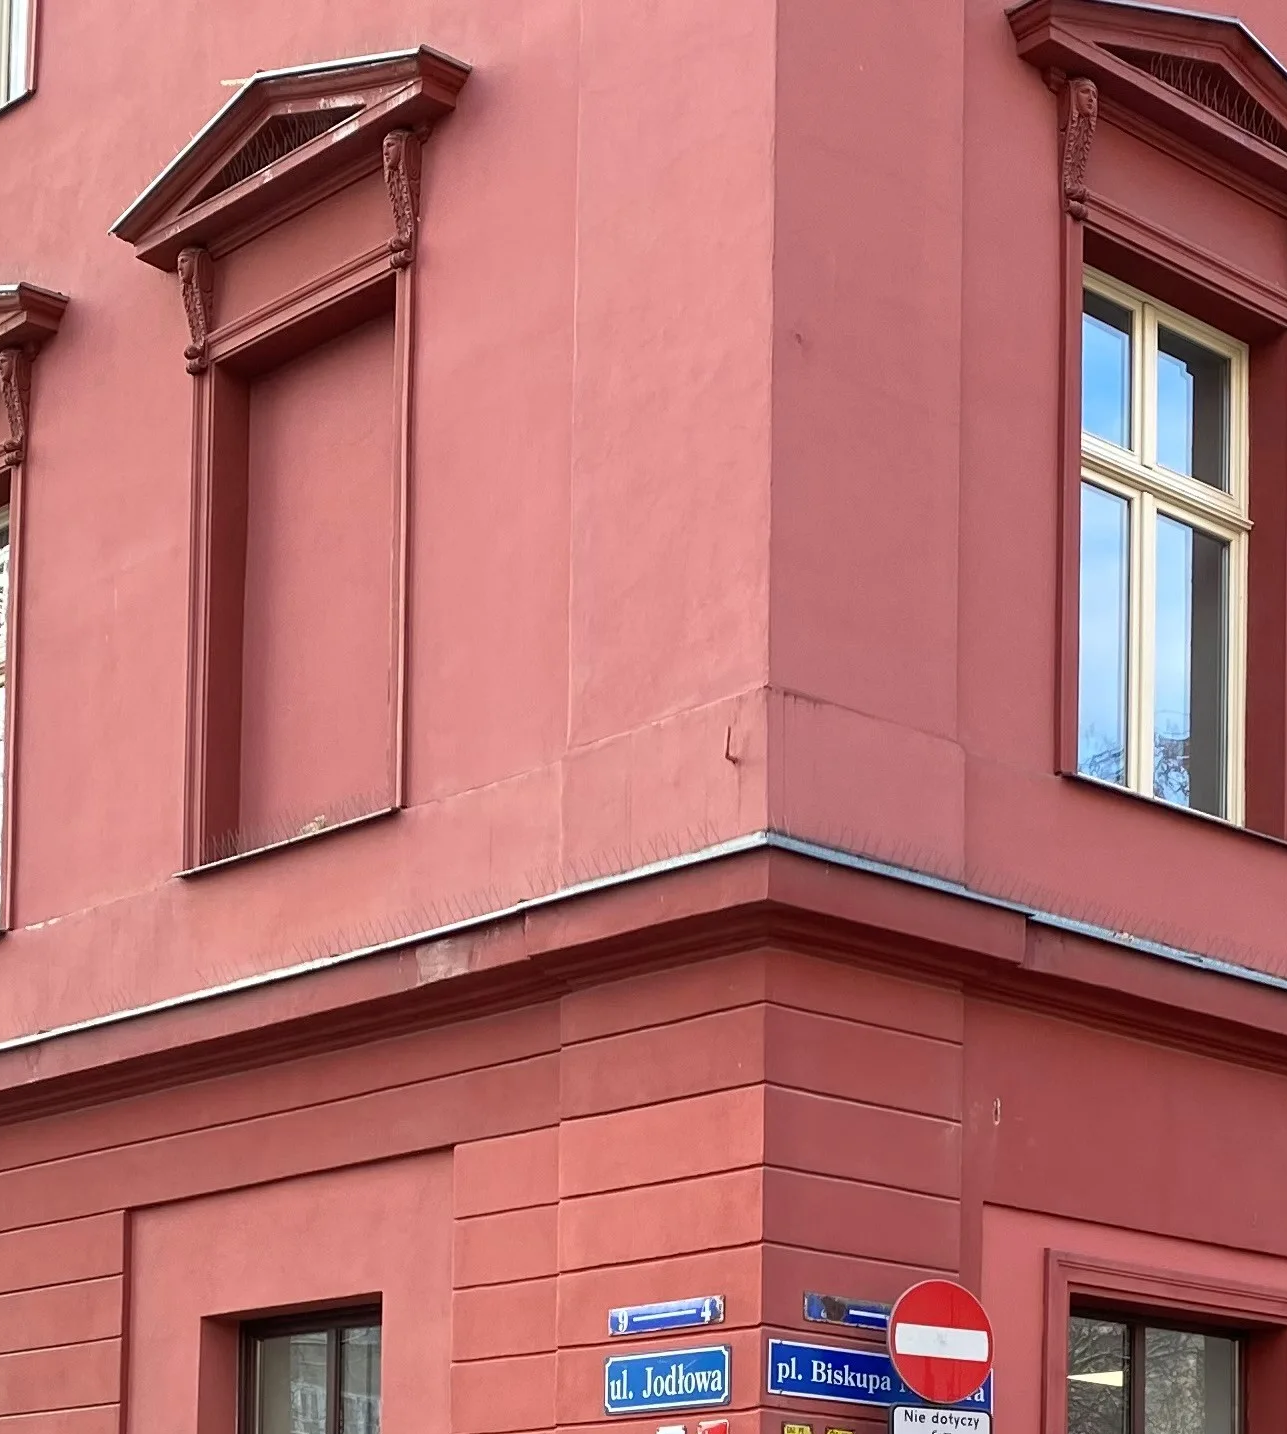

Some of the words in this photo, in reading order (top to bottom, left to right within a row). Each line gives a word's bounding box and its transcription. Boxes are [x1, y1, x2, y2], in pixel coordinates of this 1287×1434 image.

[618, 1311, 629, 1333] 9
[610, 1369, 634, 1401] ul.
[642, 1363, 722, 1399] Jodłowa
[777, 1357, 803, 1383] pl.
[810, 1360, 892, 1394] Biskupa
[904, 1409, 926, 1424] Nie
[931, 1411, 980, 1430] dotyczy
